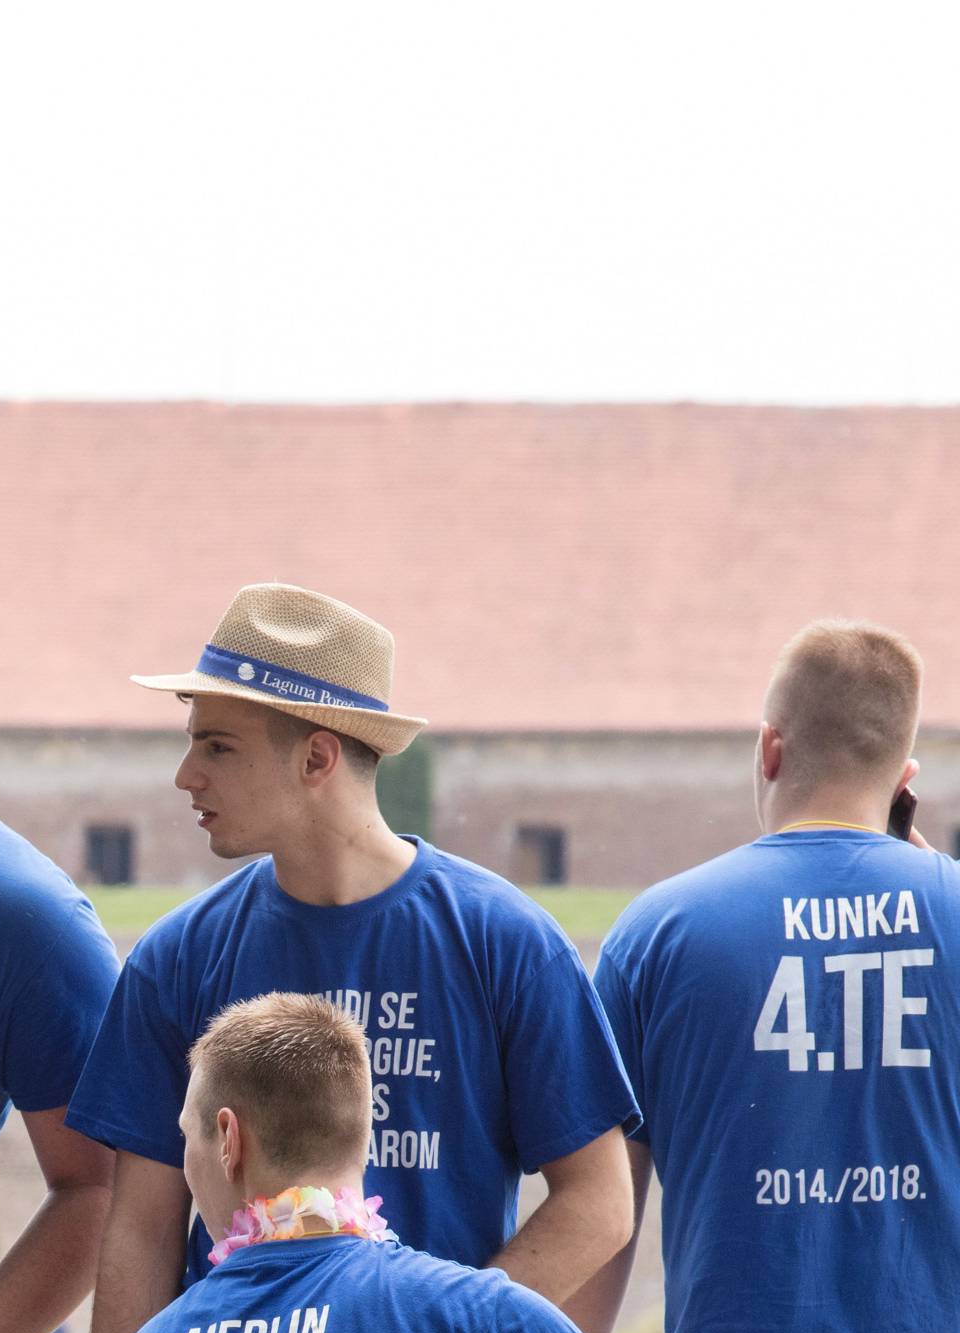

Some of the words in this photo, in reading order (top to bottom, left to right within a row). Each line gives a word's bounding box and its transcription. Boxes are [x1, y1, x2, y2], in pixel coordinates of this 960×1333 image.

[262, 671, 316, 699] Laguna
[783, 890, 920, 941] KUNKA
[378, 991, 418, 1030] SE
[753, 948, 934, 1072] 4.TE
[372, 1083, 390, 1121] S
[755, 1164, 927, 1205] 2014./2018.
